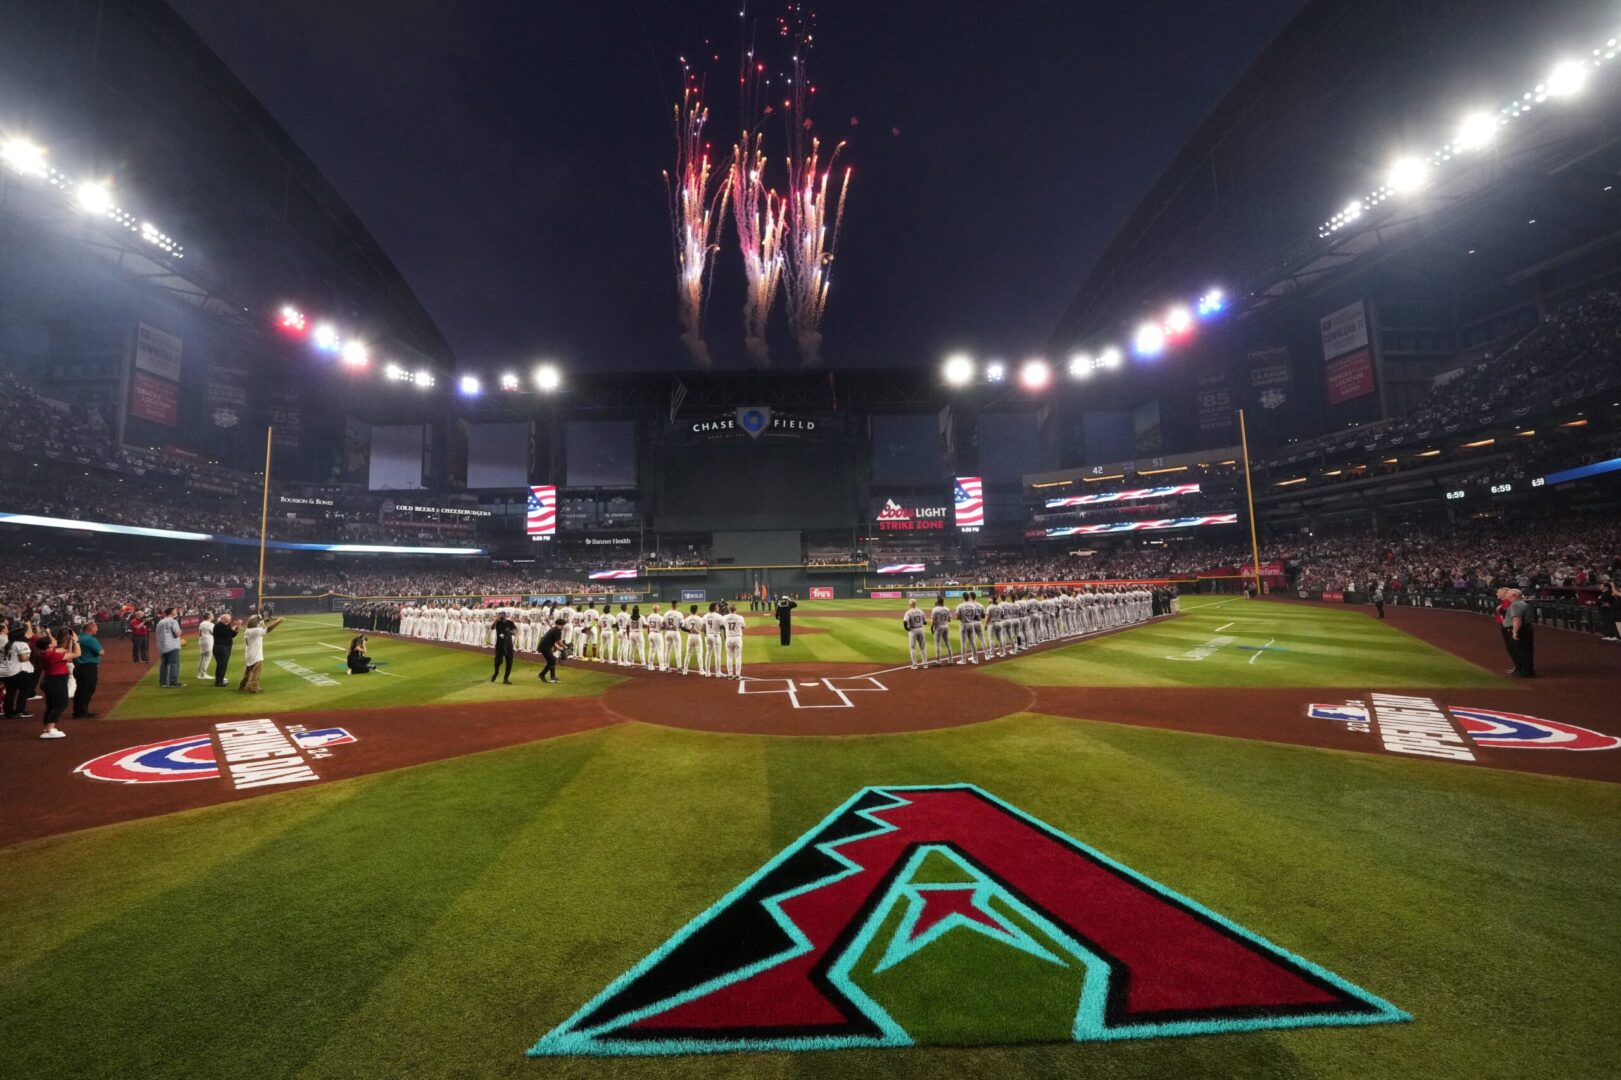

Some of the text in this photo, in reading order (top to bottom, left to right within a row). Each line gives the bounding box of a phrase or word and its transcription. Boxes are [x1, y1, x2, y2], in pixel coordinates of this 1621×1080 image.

[692, 419, 815, 432] CHASE FIELD
[1092, 466, 1103, 474] 42
[1532, 477, 1545, 487] 6:59
[1491, 484, 1511, 493] 6:59
[1446, 490, 1464, 500] 6:59
[441, 508, 491, 516] CHEESEBURGERS
[916, 507, 947, 518] LIGHT
[880, 521, 944, 530] STRIKE ZONE
[708, 620, 712, 628] 4
[728, 622, 736, 631] 17
[1346, 720, 1370, 733] 20
[1370, 692, 1477, 761] OPENING DAY
[214, 718, 298, 762] OPENING
[307, 747, 334, 760] 24
[228, 756, 320, 790] DAY
